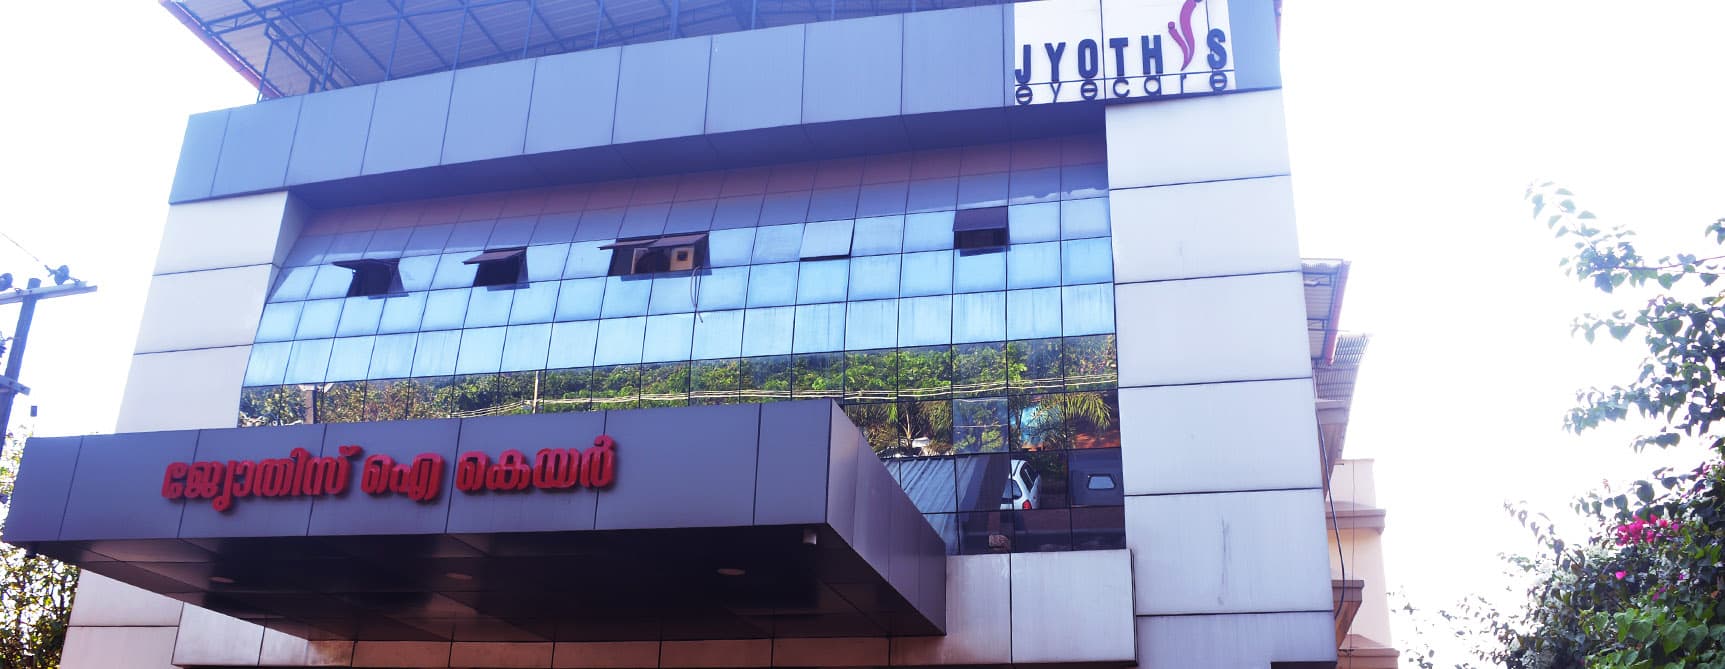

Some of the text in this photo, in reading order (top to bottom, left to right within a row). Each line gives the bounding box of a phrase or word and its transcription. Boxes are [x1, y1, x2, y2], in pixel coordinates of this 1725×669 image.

[1015, 71, 1228, 105] eyecare
[161, 434, 615, 512] ജ്യോതിസ് ഐ കെയർ
